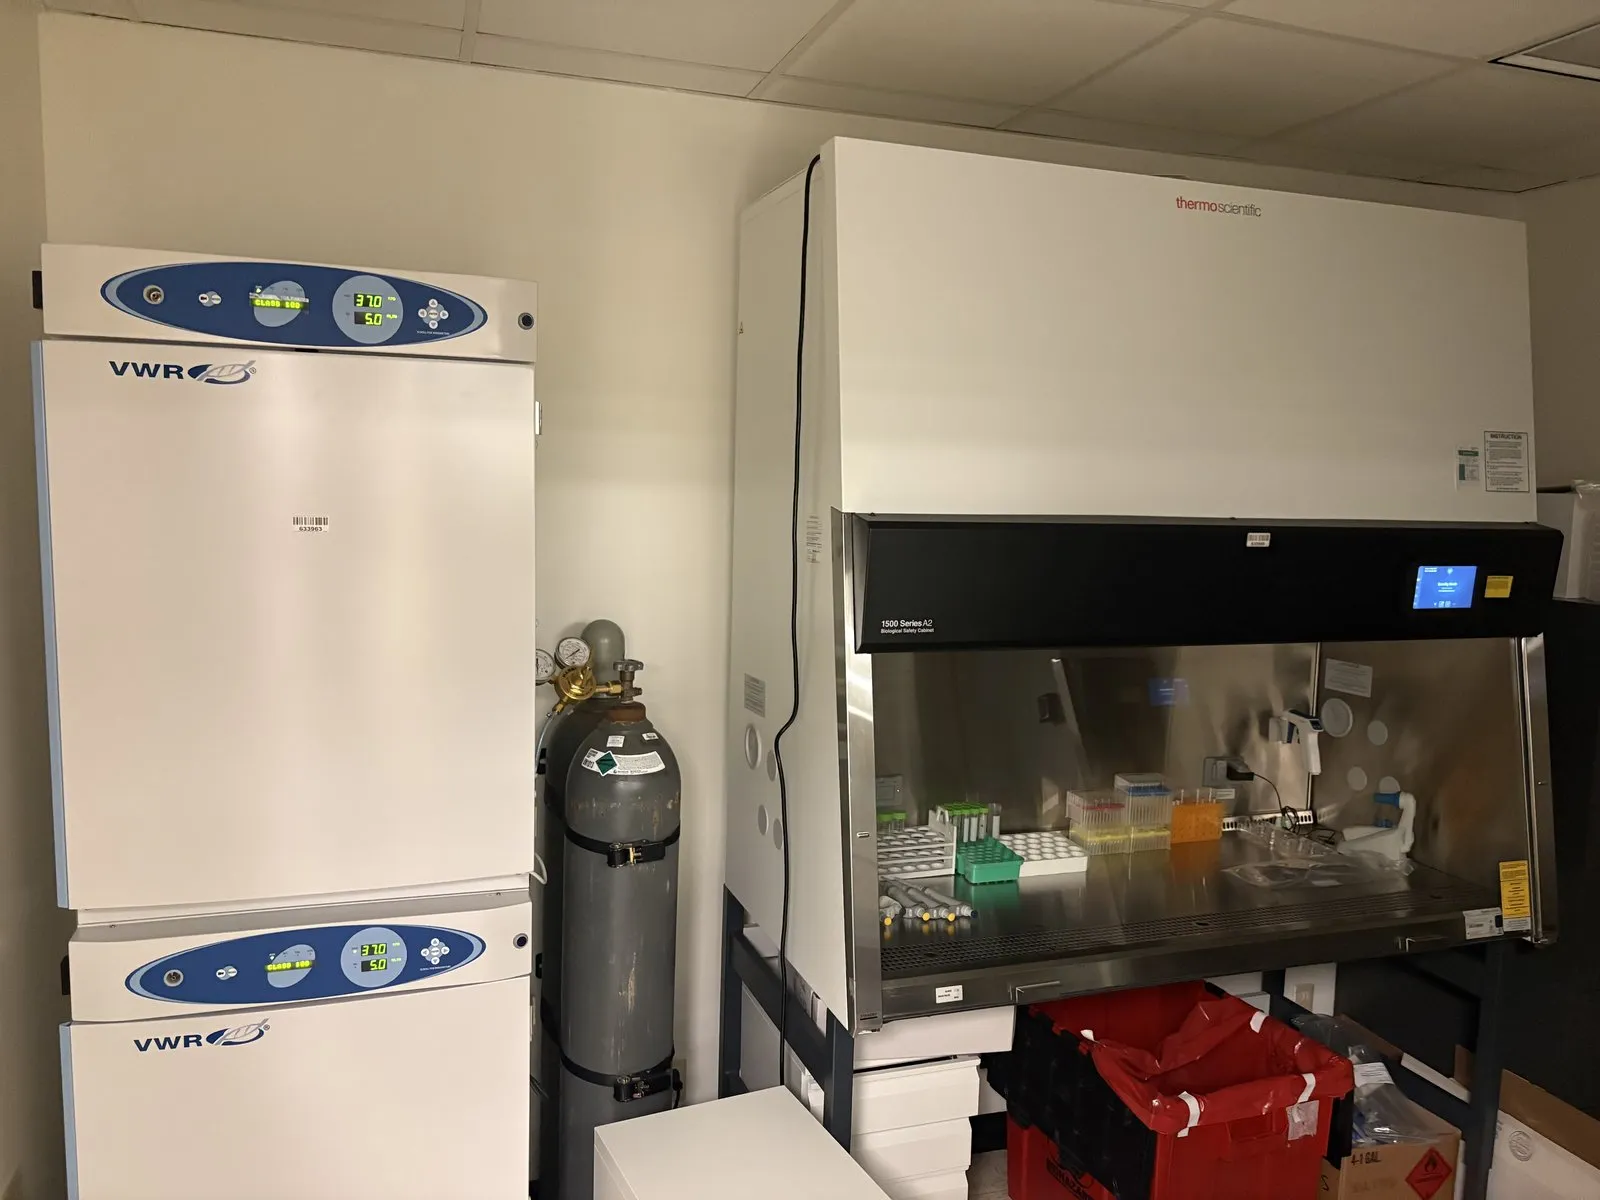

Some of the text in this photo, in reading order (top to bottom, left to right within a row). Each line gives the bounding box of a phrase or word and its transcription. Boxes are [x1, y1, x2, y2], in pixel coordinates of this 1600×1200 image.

[109, 360, 184, 380] VWR
[881, 620, 899, 628] 1500
[900, 619, 922, 628] Series
[133, 1034, 203, 1052] VWR
